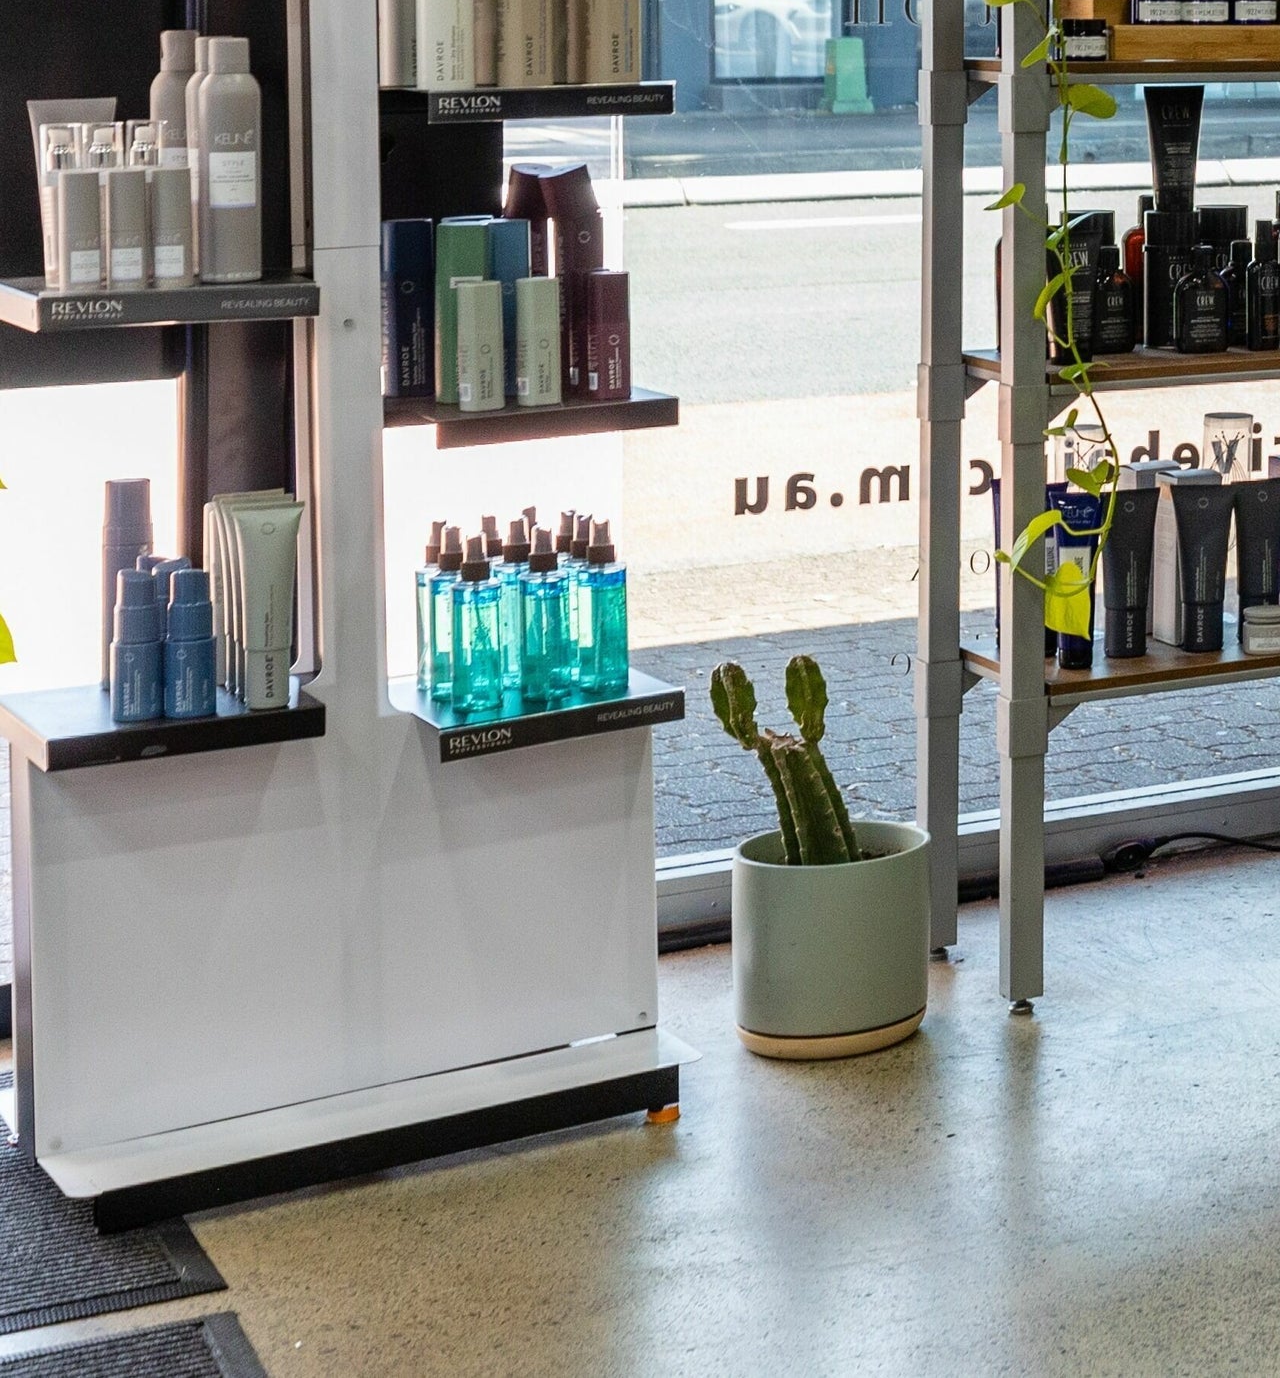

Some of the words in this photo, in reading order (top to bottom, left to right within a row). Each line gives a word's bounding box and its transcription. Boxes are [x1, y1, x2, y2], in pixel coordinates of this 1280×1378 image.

[436, 40, 444, 82] DAVROE
[439, 95, 501, 110] REVLON
[587, 95, 632, 106] REVEALING
[633, 93, 664, 103] BEAUTY
[51, 299, 123, 315] REVLON
[221, 299, 272, 311] REVEALING
[273, 297, 310, 308] BEAUTY
[1197, 295, 1215, 307] CREW
[402, 345, 411, 387] DAVROE
[1126, 611, 1134, 649] DAVROE
[1196, 607, 1204, 643] DAVROE
[265, 654, 274, 699] DAVROE
[597, 707, 642, 723] REVEALING
[643, 700, 675, 716] BEAUTY
[449, 727, 512, 750] REVLON
